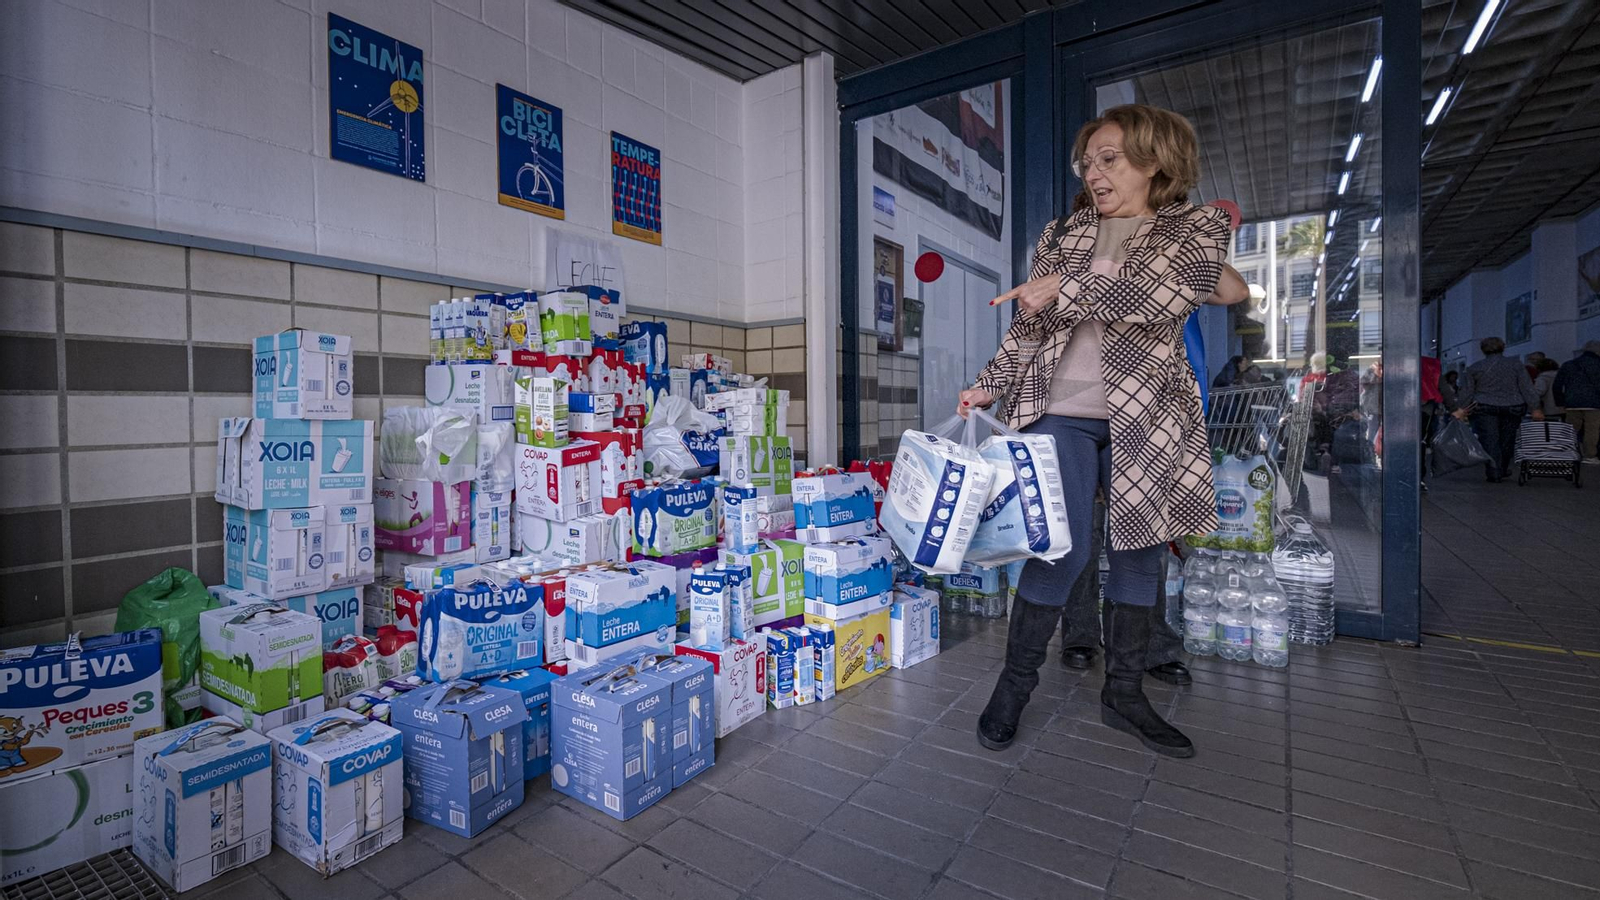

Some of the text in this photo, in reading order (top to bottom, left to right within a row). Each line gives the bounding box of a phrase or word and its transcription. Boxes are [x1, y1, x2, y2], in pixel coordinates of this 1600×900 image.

[329, 29, 423, 84] CLIMA
[513, 101, 552, 132] BICI
[501, 115, 562, 153] CLETA
[612, 137, 659, 166] TEMPE-
[611, 151, 661, 180] RATURA
[555, 247, 616, 288] LECHE
[595, 310, 615, 320] ENTERA
[318, 336, 336, 345] XOIA
[254, 355, 277, 377] XOIA
[465, 382, 481, 390] Leche
[258, 440, 315, 462] XOIA
[523, 449, 548, 461] COVAP
[571, 450, 592, 459] ENTERA
[771, 446, 792, 460] XOIA
[276, 466, 281, 474] 6
[282, 466, 287, 474] X
[265, 478, 307, 490] LECHE MILK
[665, 489, 707, 507] PULEVA
[290, 511, 310, 520] XOIA
[340, 507, 357, 516] XOIA
[830, 510, 855, 523] ENTERA
[674, 515, 705, 533] ORIGINAL
[226, 522, 247, 546] XOIA
[808, 555, 828, 564] ENTERA
[692, 578, 721, 588] PULEVA
[840, 581, 853, 590] Leche
[952, 576, 980, 588] DEHESA
[454, 587, 528, 610] PULEVA
[569, 586, 588, 599] ENTERA
[840, 585, 868, 601] ENTERA
[313, 597, 359, 623] XOIA
[694, 596, 719, 607] ORIGINAL
[912, 598, 931, 613] COVAP
[603, 616, 620, 628] Leche
[706, 614, 722, 623] A+D
[466, 621, 519, 646] ORIGINAL
[602, 620, 640, 642] ENTERA
[269, 633, 315, 651] SEMIDESNATADA
[481, 650, 502, 663] A+D
[733, 643, 758, 662] COVAP
[0, 653, 135, 694] PULEVA
[202, 669, 257, 707] SEMIDESNATADA
[525, 691, 549, 706] ENTERA
[42, 700, 129, 728] Peques
[132, 691, 155, 715] 3
[736, 701, 756, 717] ENTERA
[65, 715, 135, 735] Crecimiento
[69, 731, 84, 740] con
[85, 723, 131, 737] Cereales
[572, 716, 598, 733] entera
[415, 734, 442, 749] entera
[278, 743, 309, 768] COVAP
[343, 744, 392, 774] COVAP
[143, 756, 168, 782] COVAP
[187, 751, 266, 787] SEMIDESNATADA
[684, 757, 705, 776] entera
[638, 785, 662, 805] entera
[487, 798, 513, 821] entera
[111, 831, 131, 841] LECHE
[1, 869, 25, 882] 6x1L
